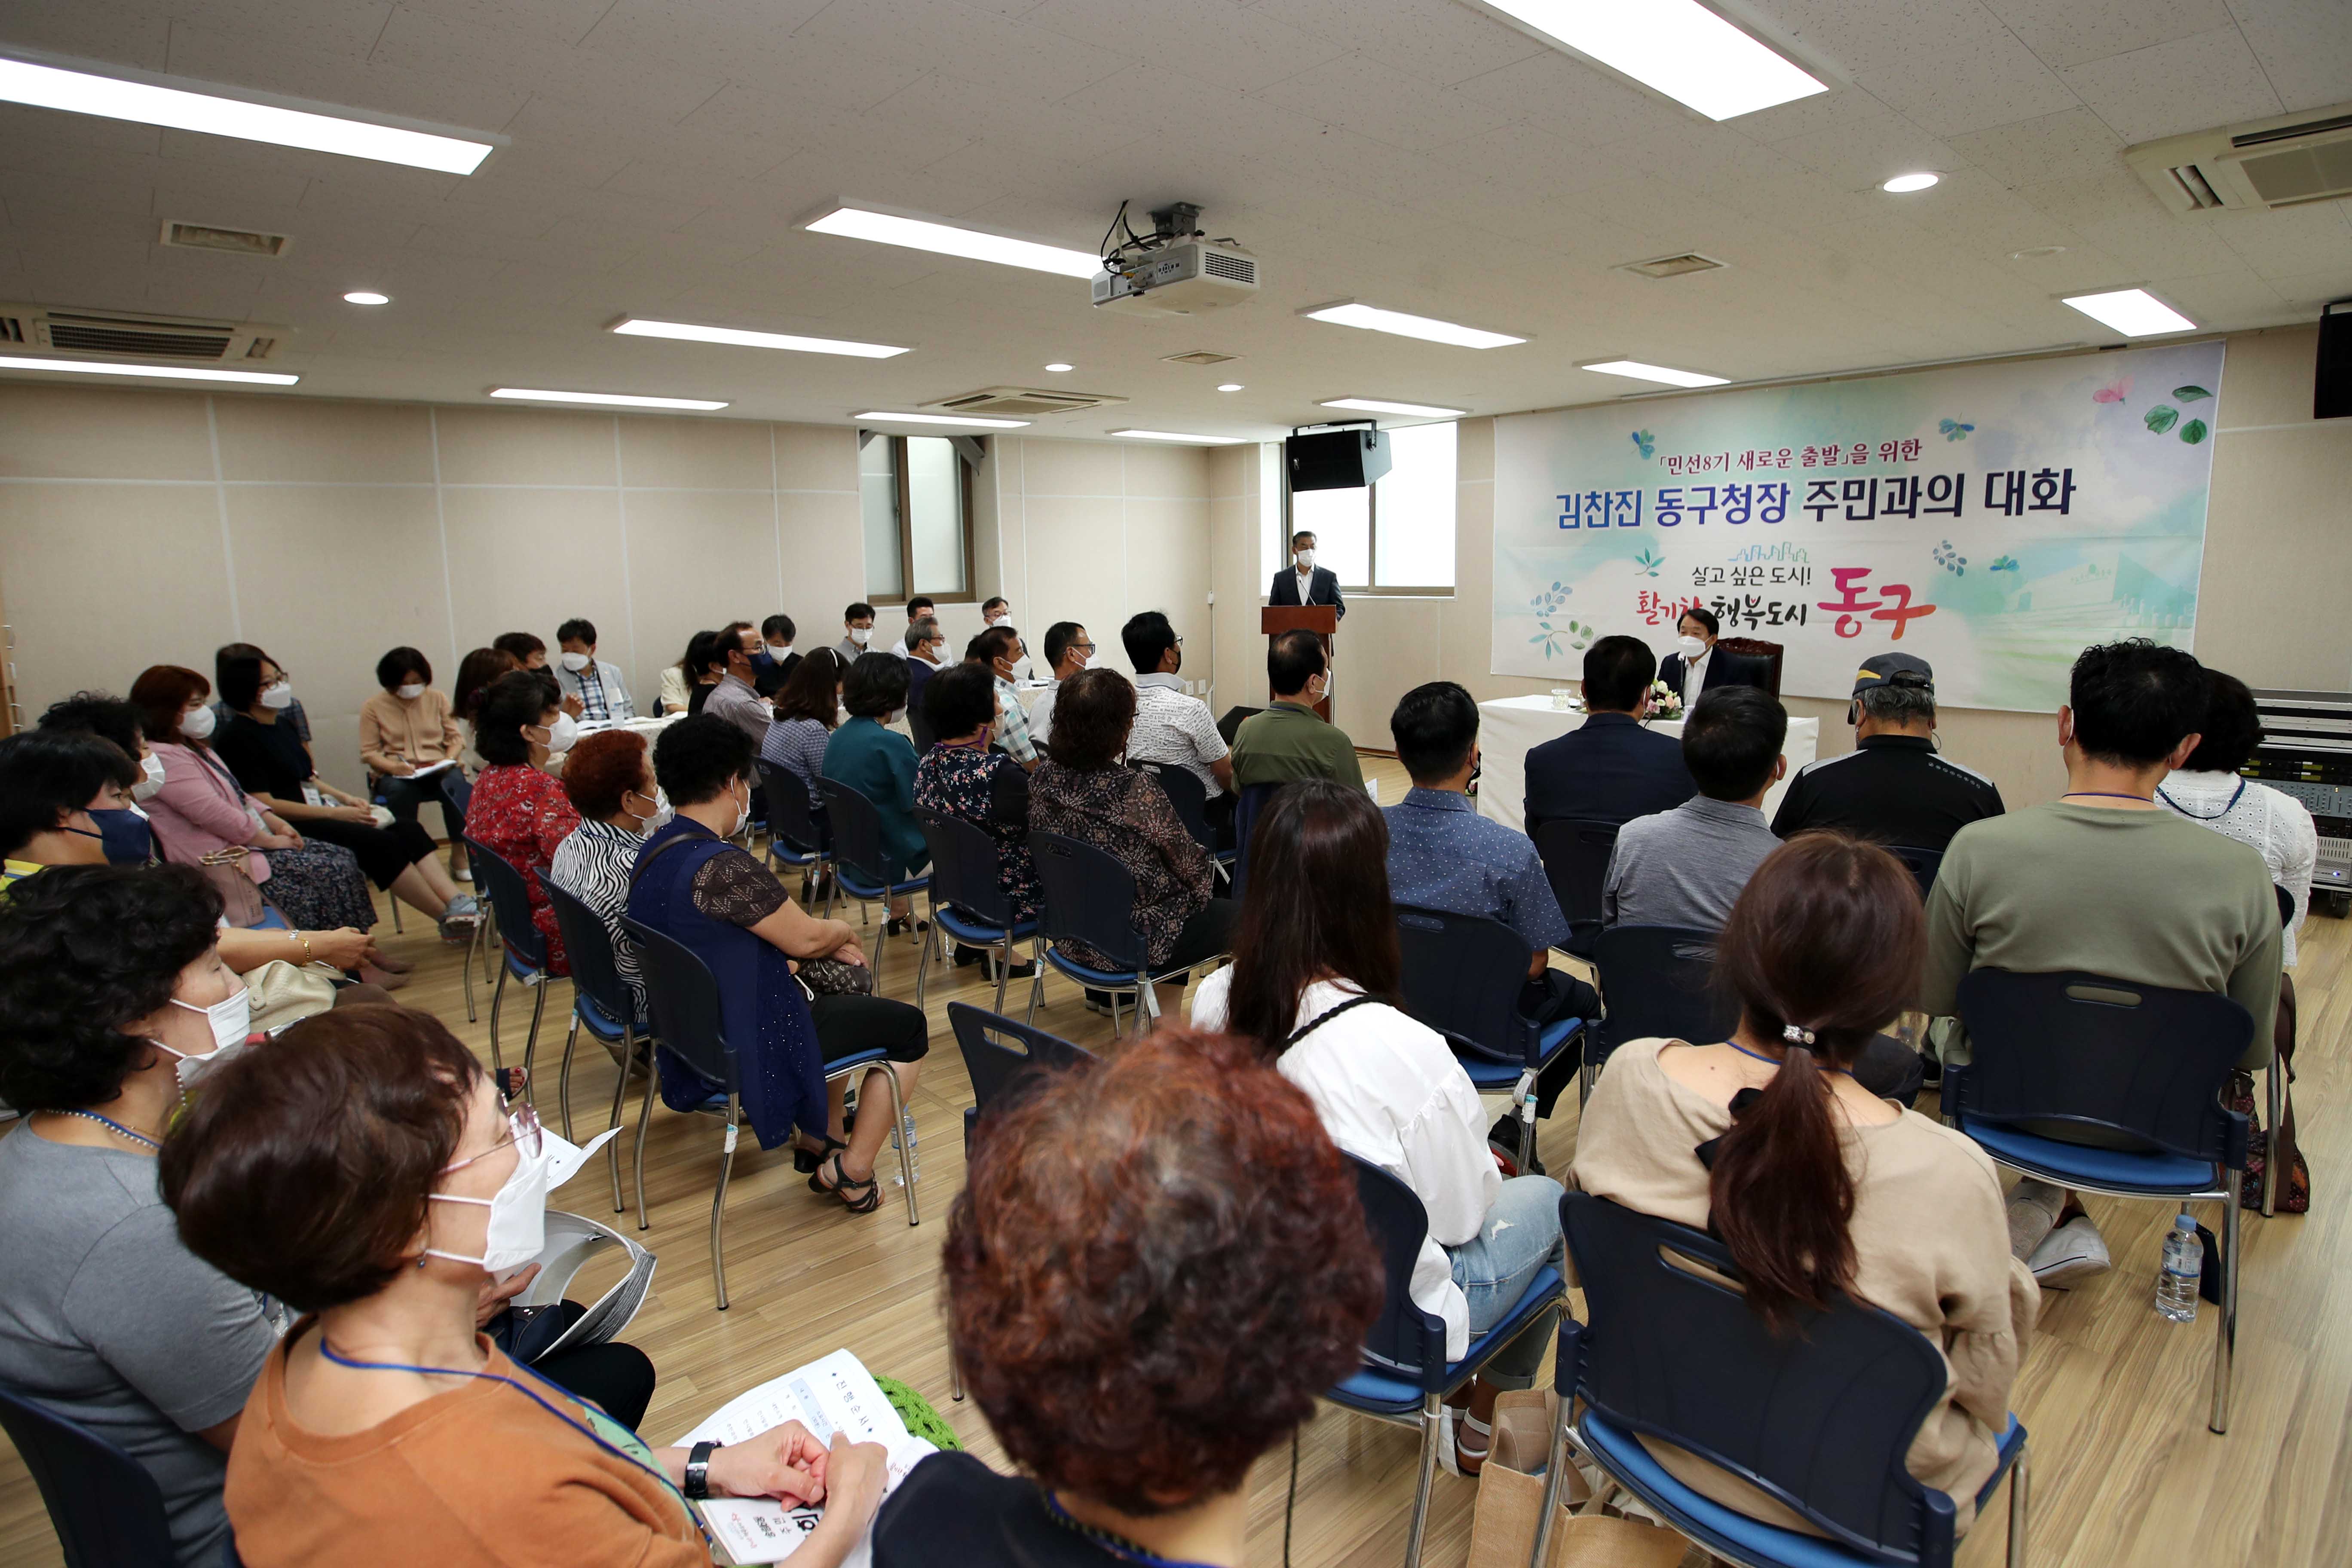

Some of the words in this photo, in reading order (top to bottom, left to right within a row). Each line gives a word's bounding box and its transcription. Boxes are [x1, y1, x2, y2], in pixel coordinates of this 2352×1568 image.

[1737, 448, 1793, 471] 새로운
[1878, 438, 1923, 463] 위한
[1556, 489, 1642, 529] 김찬진
[1655, 482, 1791, 527] 동구청장
[1803, 473, 1965, 522] 주민과의
[1984, 468, 2077, 516] 대화
[1692, 566, 1725, 586] 살고
[1730, 566, 1765, 586] 싶은
[1770, 567, 1811, 586] 도시!
[1710, 594, 1807, 631] 행복도시
[1816, 567, 1936, 640] 동구
